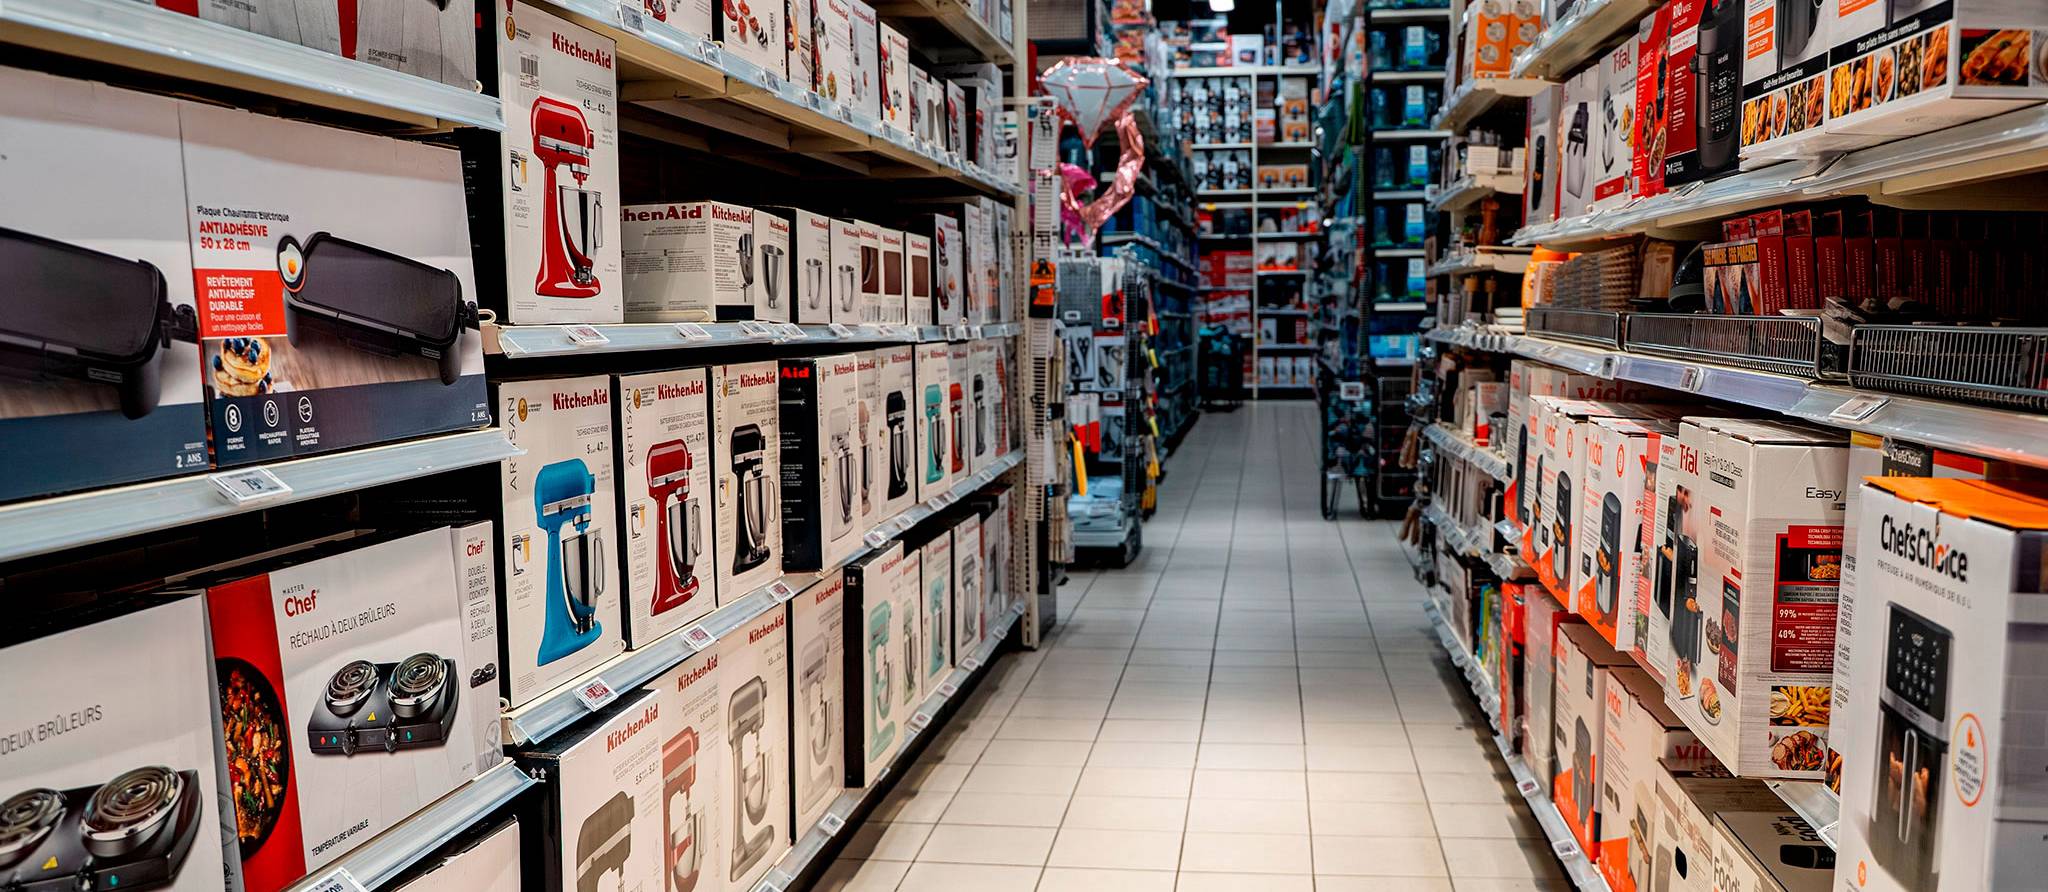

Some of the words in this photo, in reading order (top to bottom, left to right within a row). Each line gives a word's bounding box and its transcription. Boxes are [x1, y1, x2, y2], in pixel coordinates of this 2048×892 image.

[552, 32, 612, 69] KitchenAid
[712, 205, 751, 224] KitchenAid
[200, 220, 268, 237] ANTIADHÉSIVE
[201, 237, 213, 249] 50
[216, 240, 221, 249] x
[224, 238, 234, 250] 28
[237, 240, 250, 251] cm
[207, 275, 253, 287] REVÊTEMENT
[208, 286, 255, 299] ANTIADHÉSIF
[209, 301, 244, 311] DURABLE
[211, 312, 225, 322] Pour
[236, 313, 254, 321] cuisson
[219, 322, 246, 333] nettoyage
[247, 322, 264, 331] faciles
[740, 371, 776, 388] KitchenAid
[781, 367, 809, 379] Aid
[658, 380, 704, 400] KitchenAid
[553, 389, 608, 410] KitchenAid
[625, 388, 635, 466] ARTISAN
[508, 397, 518, 491] ARSAN
[176, 455, 183, 468] 2
[187, 452, 202, 463] ANS
[1680, 443, 1699, 476] T-fal
[1806, 487, 1842, 501] Easy
[467, 540, 484, 556] Chef
[282, 584, 305, 594] MASTER
[285, 589, 317, 617] Chef
[1780, 609, 1797, 618] 99%
[290, 625, 331, 650] RÉCHAUD
[338, 616, 359, 634] DEUX
[359, 603, 396, 626] BRÛLEURS
[748, 613, 784, 645] KitchenAid
[1778, 629, 1796, 639] 40%
[677, 654, 718, 692] KitchenAid
[1, 727, 36, 755] DEUX
[38, 704, 102, 742] BRÛLEURS
[607, 703, 658, 753] KitchenAid
[346, 818, 369, 838] VARIABLE
